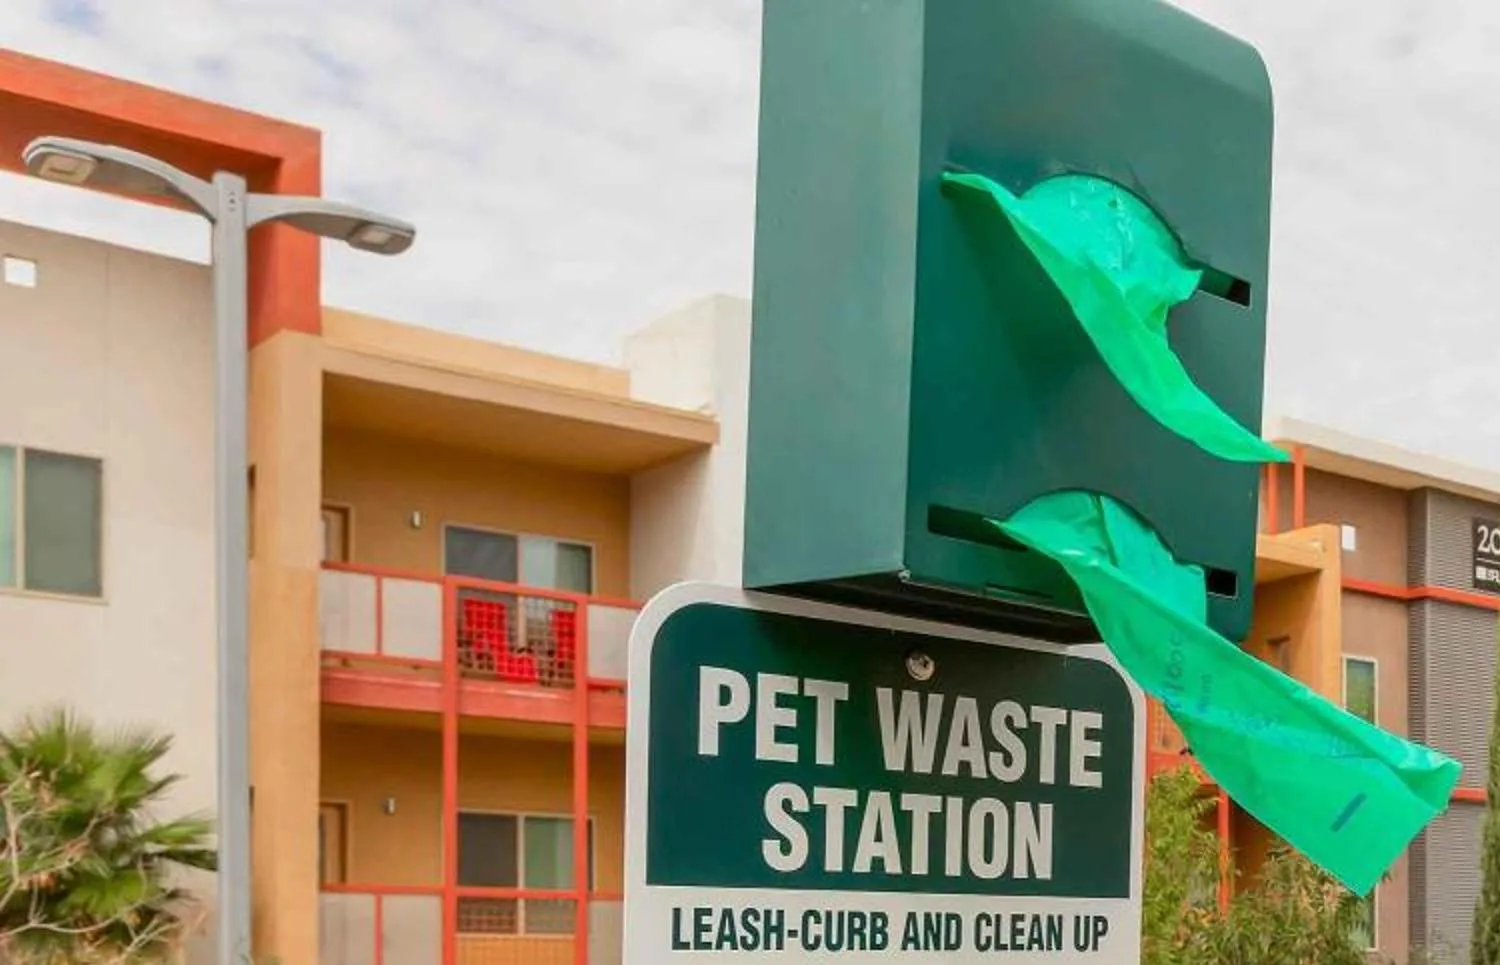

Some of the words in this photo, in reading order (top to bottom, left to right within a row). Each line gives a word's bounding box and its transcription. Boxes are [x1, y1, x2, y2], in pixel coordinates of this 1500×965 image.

[698, 666, 849, 765] PET
[875, 687, 1103, 788] WASTE
[761, 782, 1053, 880] STATION
[671, 907, 889, 951] LEASH-CURB
[901, 911, 963, 951] AND
[974, 911, 1063, 952] CLEAN
[1074, 914, 1109, 953] UP
